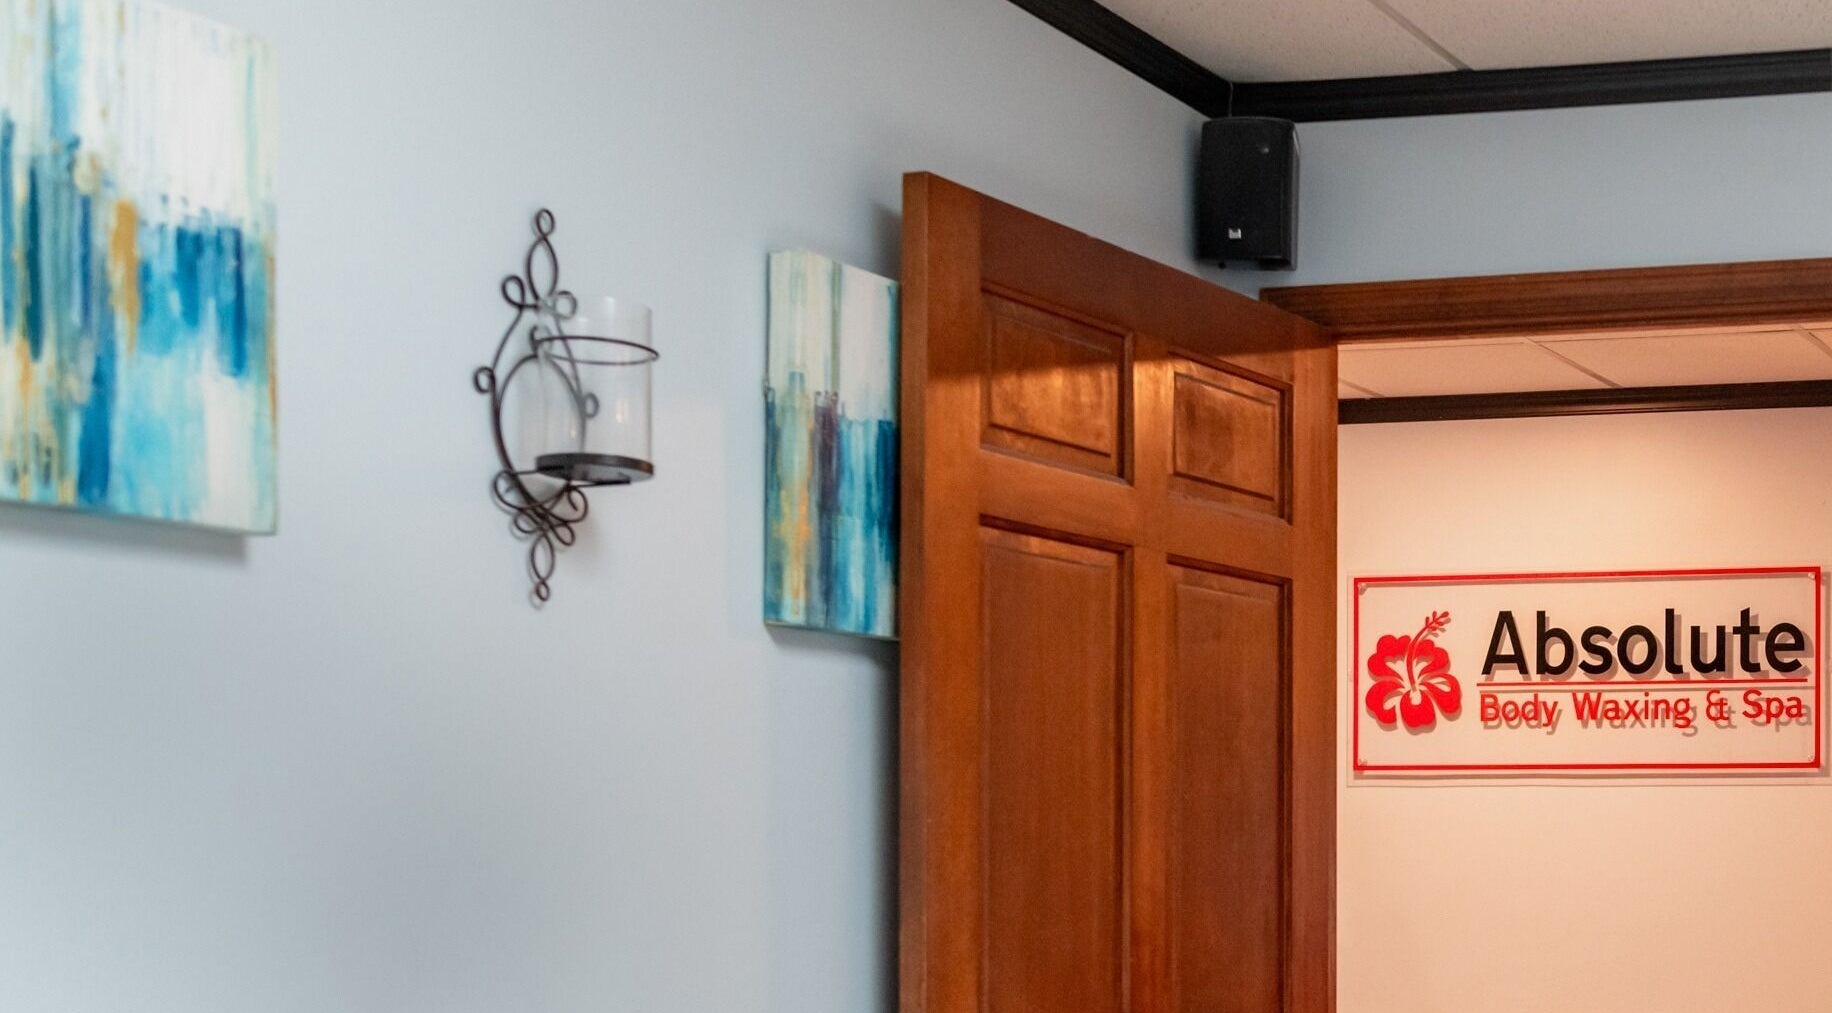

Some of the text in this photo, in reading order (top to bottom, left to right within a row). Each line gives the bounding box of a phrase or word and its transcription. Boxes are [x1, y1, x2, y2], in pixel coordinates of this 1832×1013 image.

[1481, 607, 1805, 676] Absolute
[1479, 688, 1803, 729] Body Waxing & Spa
